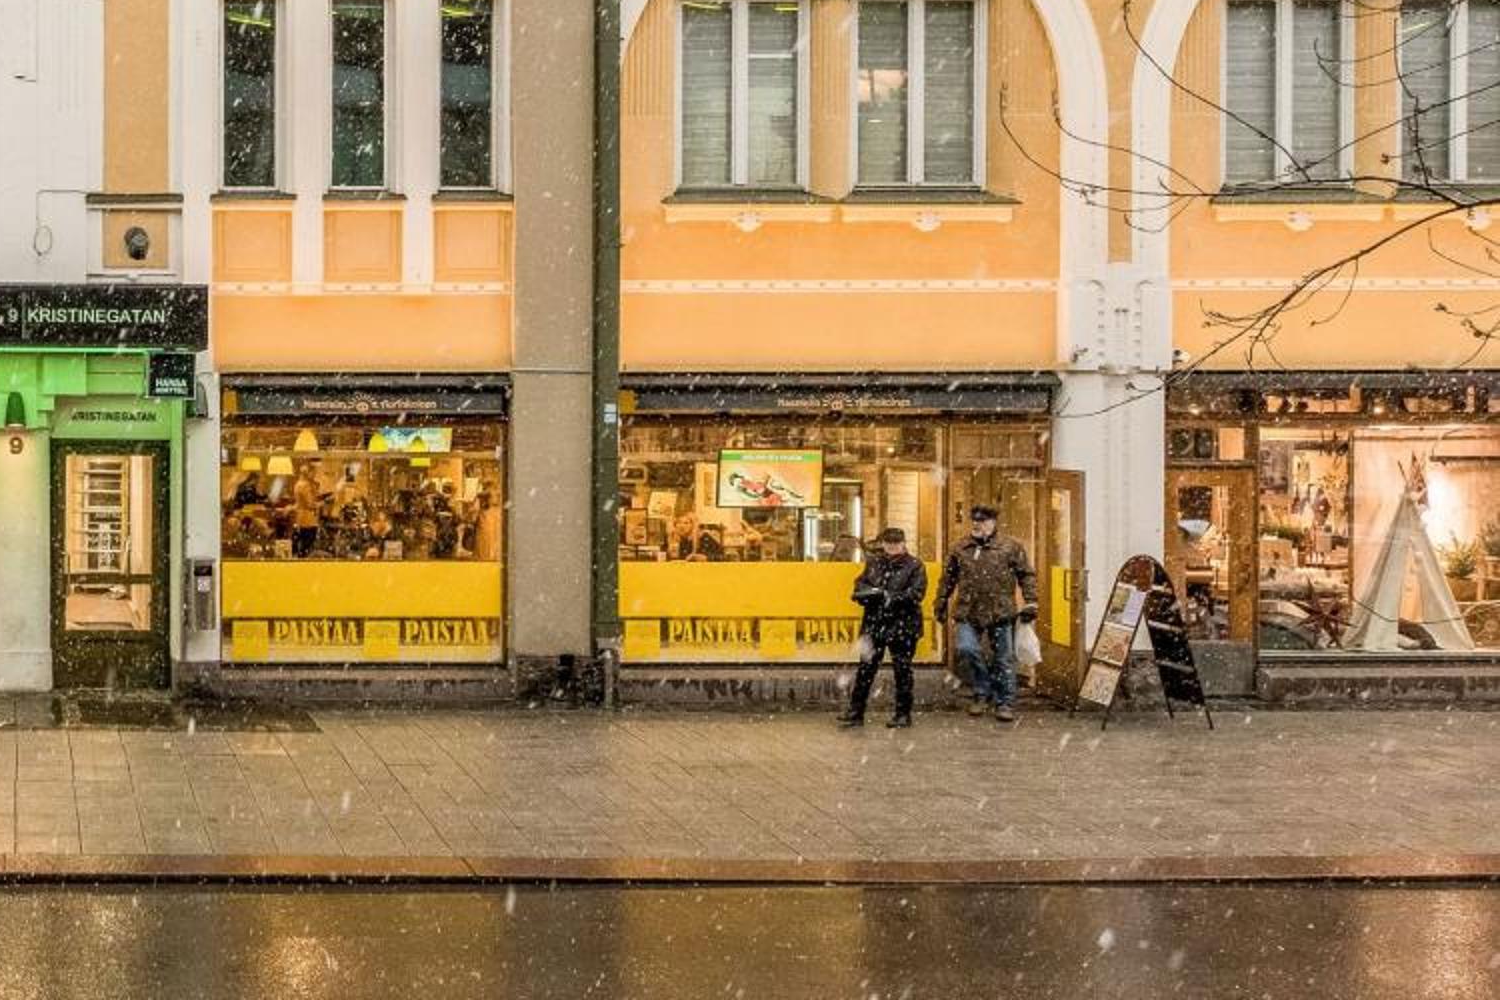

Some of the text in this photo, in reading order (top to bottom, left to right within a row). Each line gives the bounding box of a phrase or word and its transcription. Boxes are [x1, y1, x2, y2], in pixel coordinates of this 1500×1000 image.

[8, 308, 18, 322] 9
[28, 308, 166, 324] KRISTINEGATAN
[10, 436, 24, 454] 9
[274, 620, 489, 643] PAISTAA PAISTAA
[668, 619, 753, 643] PAISTAA
